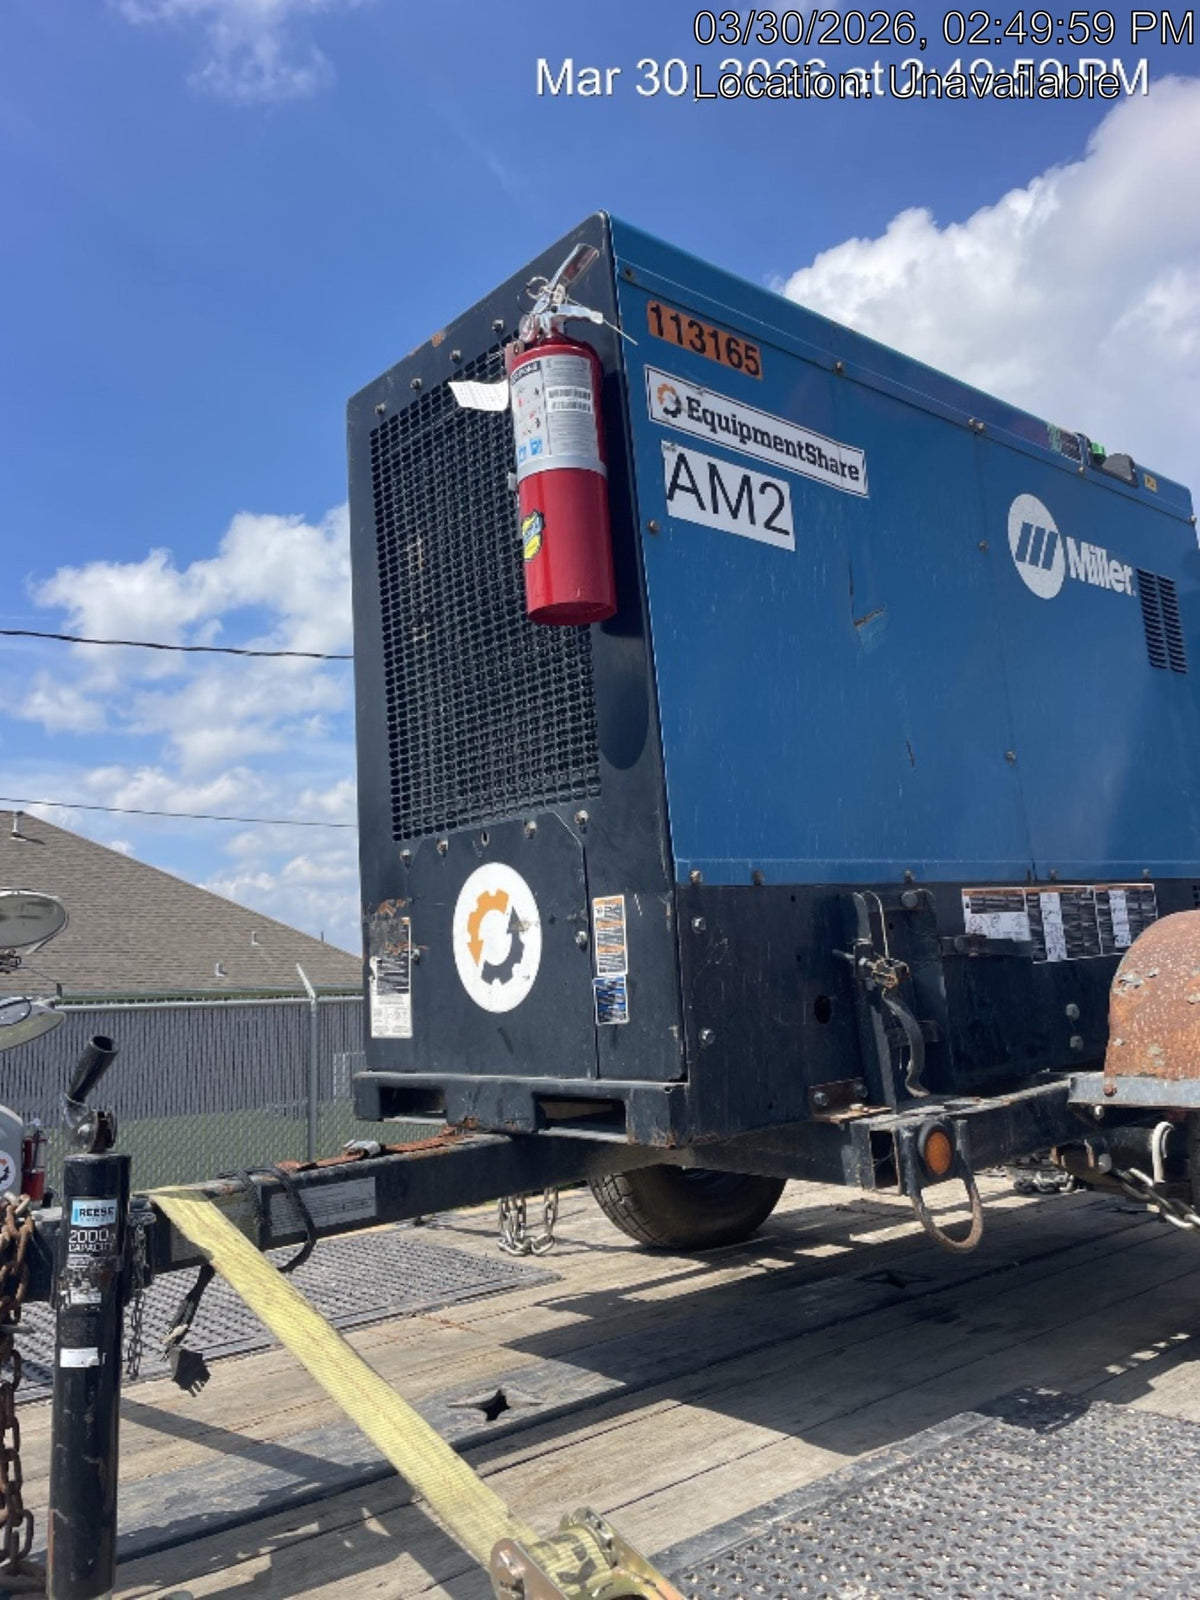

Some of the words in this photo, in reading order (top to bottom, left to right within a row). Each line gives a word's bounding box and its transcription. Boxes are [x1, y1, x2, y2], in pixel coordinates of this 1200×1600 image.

[650, 304, 760, 376] 113165
[686, 395, 859, 482] EquipmentShare
[666, 453, 790, 536] AM2
[1066, 536, 1133, 596] Miller
[69, 1228, 109, 1243] 2000
